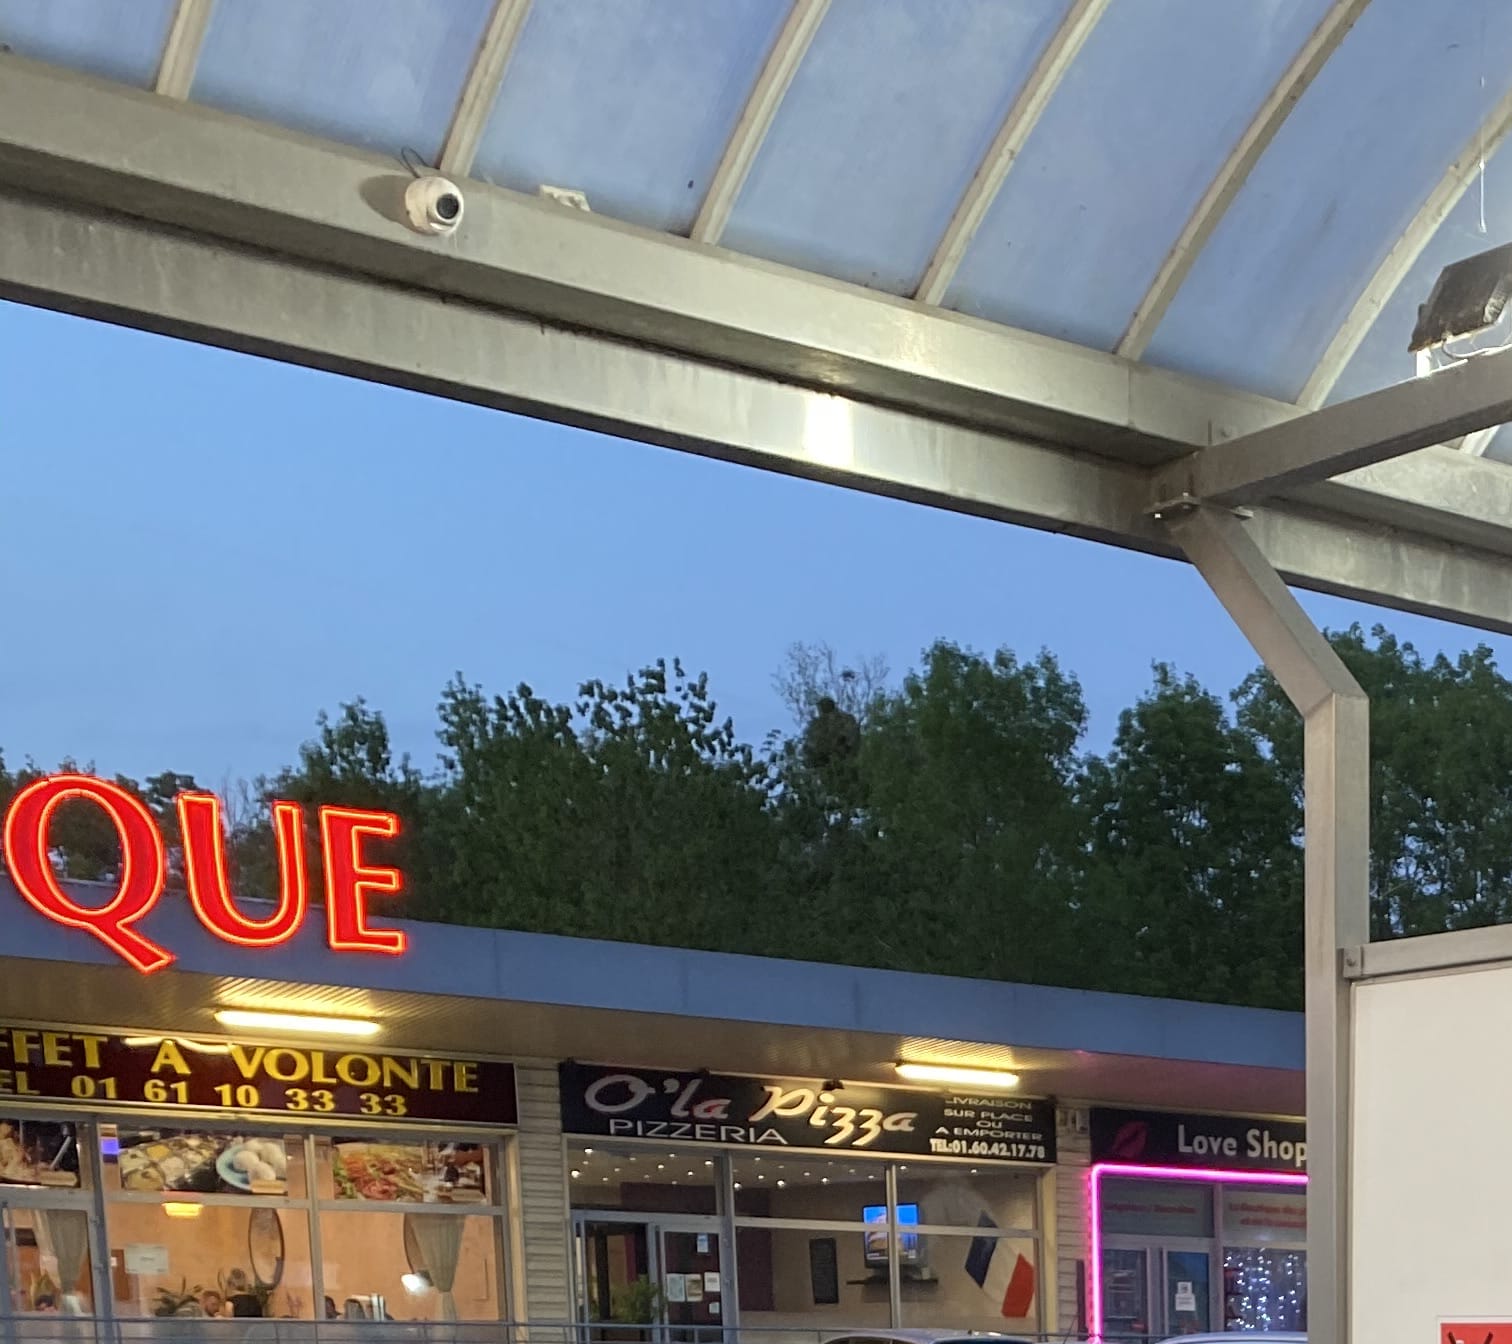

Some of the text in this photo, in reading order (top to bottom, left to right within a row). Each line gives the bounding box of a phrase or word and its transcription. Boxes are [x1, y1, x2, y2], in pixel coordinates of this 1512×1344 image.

[3, 773, 408, 974] QUE
[150, 1039, 192, 1075] A
[231, 1044, 479, 1093] VOLONTE
[71, 1074, 118, 1100] 01
[143, 1078, 188, 1104] 61
[214, 1083, 260, 1108] 10
[285, 1087, 336, 1113] 33
[359, 1092, 407, 1117] 33
[944, 1096, 1032, 1110] LIVRAISON
[943, 1108, 1033, 1123] SUR PLACE
[975, 1119, 1003, 1129] OU
[608, 1117, 789, 1146] PIZZERIA
[953, 1127, 1043, 1141] EMPORTER
[1177, 1123, 1307, 1168] Love Shop
